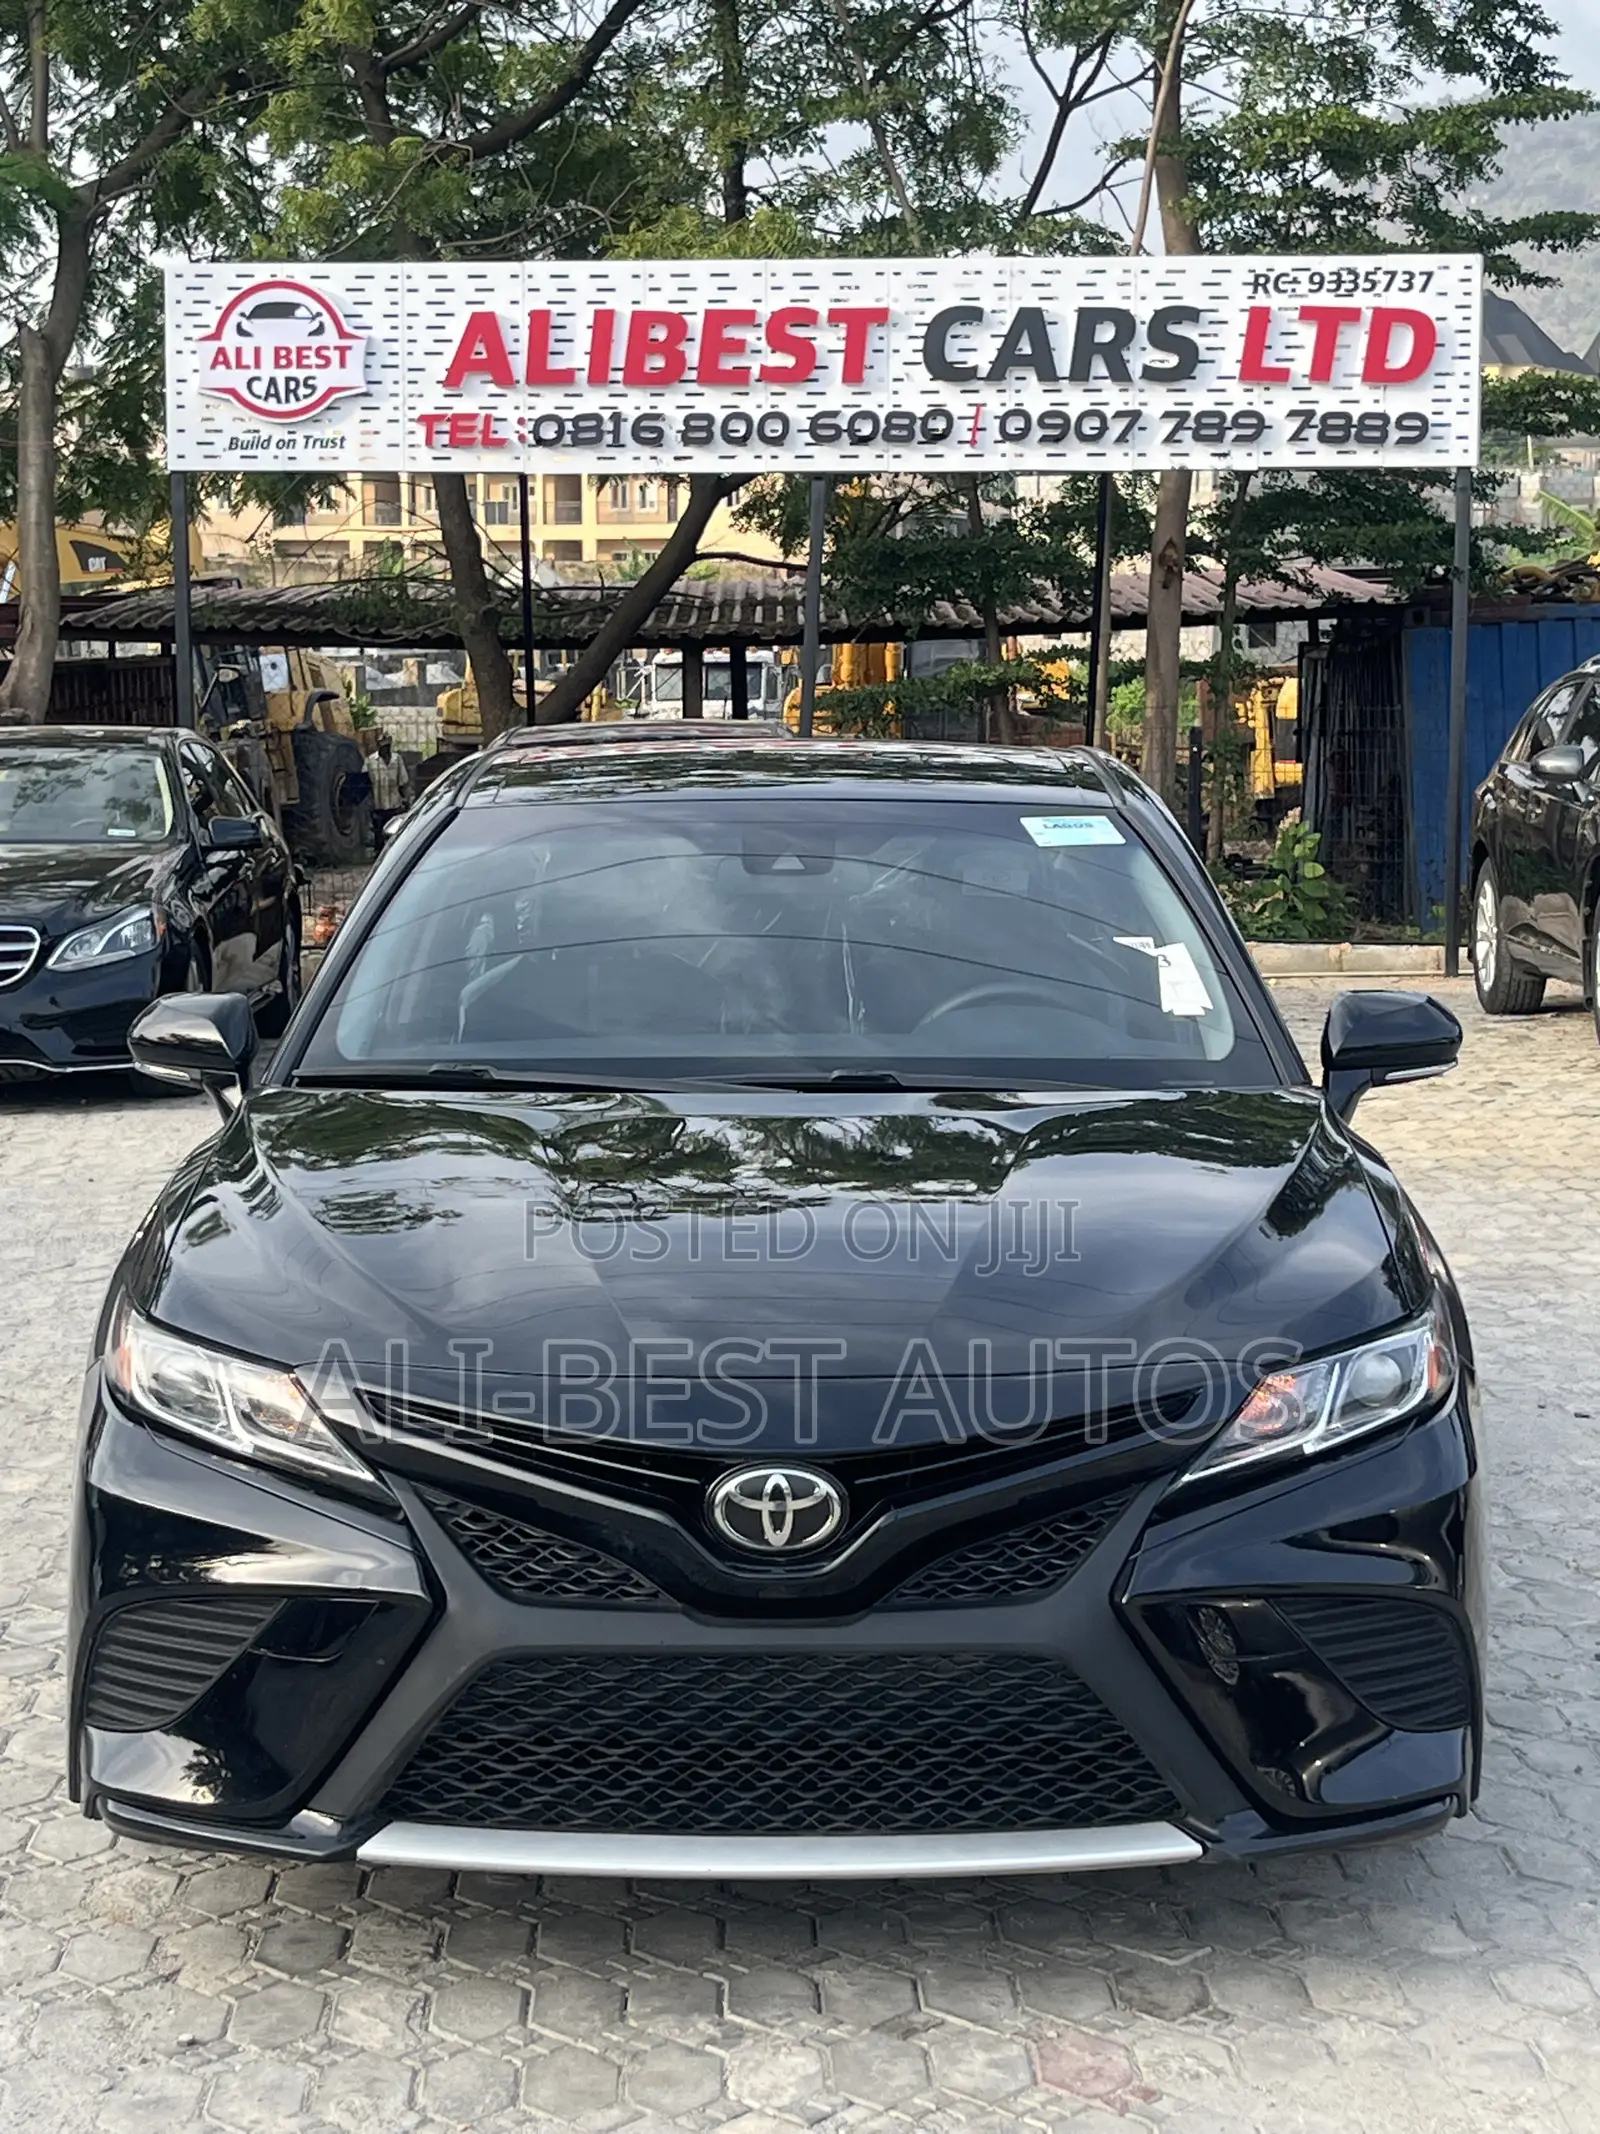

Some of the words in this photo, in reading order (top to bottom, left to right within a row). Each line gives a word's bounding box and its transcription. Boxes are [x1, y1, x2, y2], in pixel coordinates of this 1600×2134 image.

[1307, 270, 1435, 294] 9335737
[210, 346, 262, 370] ALI
[273, 345, 353, 370] BEST
[444, 307, 888, 388] ALIBEST
[922, 305, 1201, 383] CARS
[1239, 305, 1437, 384] LTD
[246, 375, 318, 404] CARS
[532, 411, 665, 448] 0816
[683, 411, 790, 446] 800
[809, 410, 953, 446] 6080
[999, 409, 1142, 444] 0907
[1160, 409, 1265, 444] 789
[1285, 410, 1430, 445] 7889
[228, 435, 273, 451] Build
[275, 440, 297, 450] on
[303, 435, 346, 449] Trust
